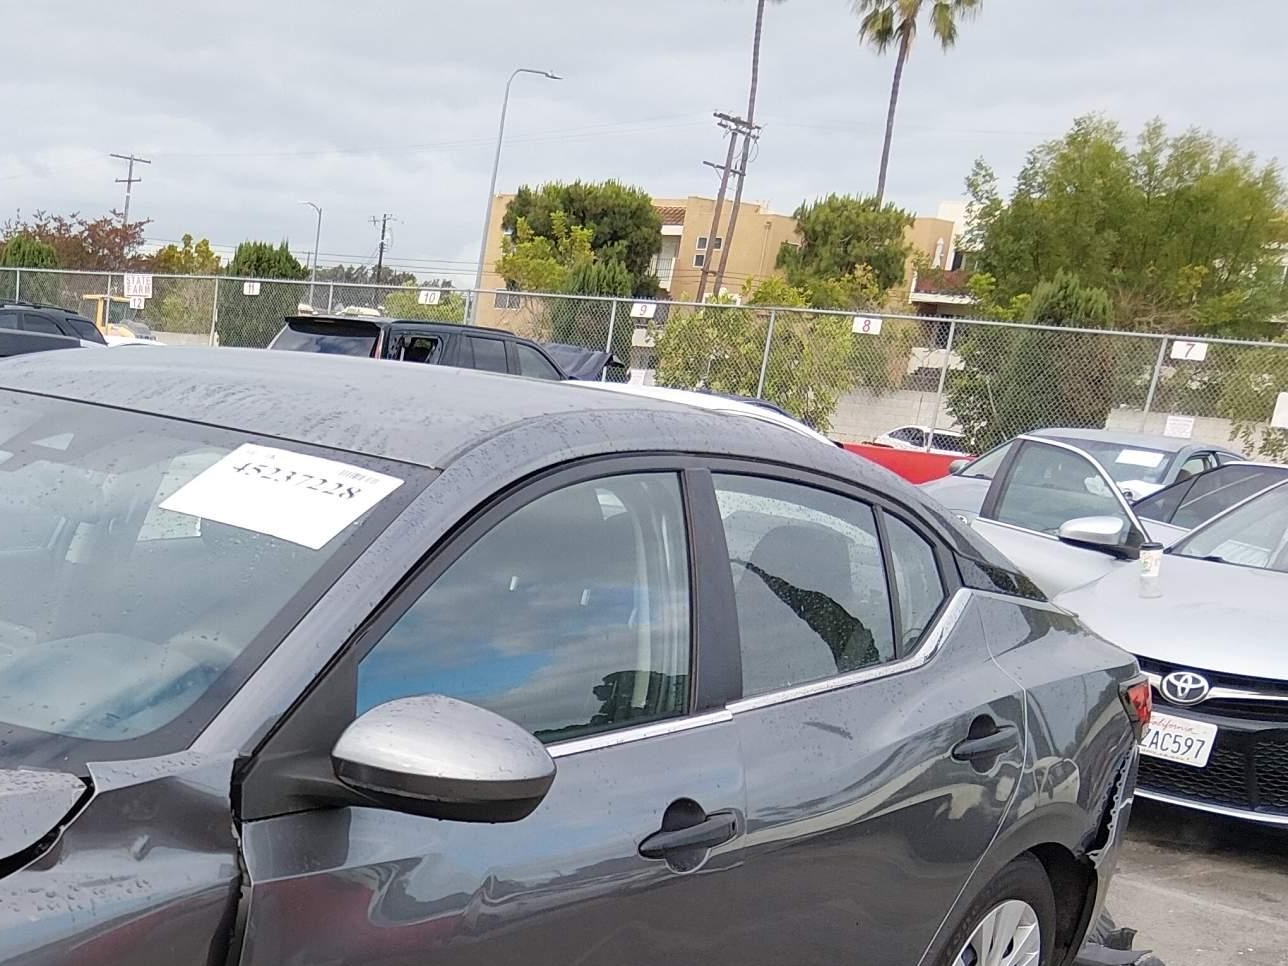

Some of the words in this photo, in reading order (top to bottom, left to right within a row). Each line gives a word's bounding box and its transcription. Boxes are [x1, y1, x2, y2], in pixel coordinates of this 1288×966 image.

[126, 275, 151, 285] STATE
[133, 298, 142, 308] 12
[424, 291, 436, 304] 10
[640, 304, 648, 316] 9
[862, 319, 871, 333] 8
[1184, 343, 1196, 358] 7
[232, 462, 362, 499] 45237228
[1151, 718, 1194, 733] alifornia
